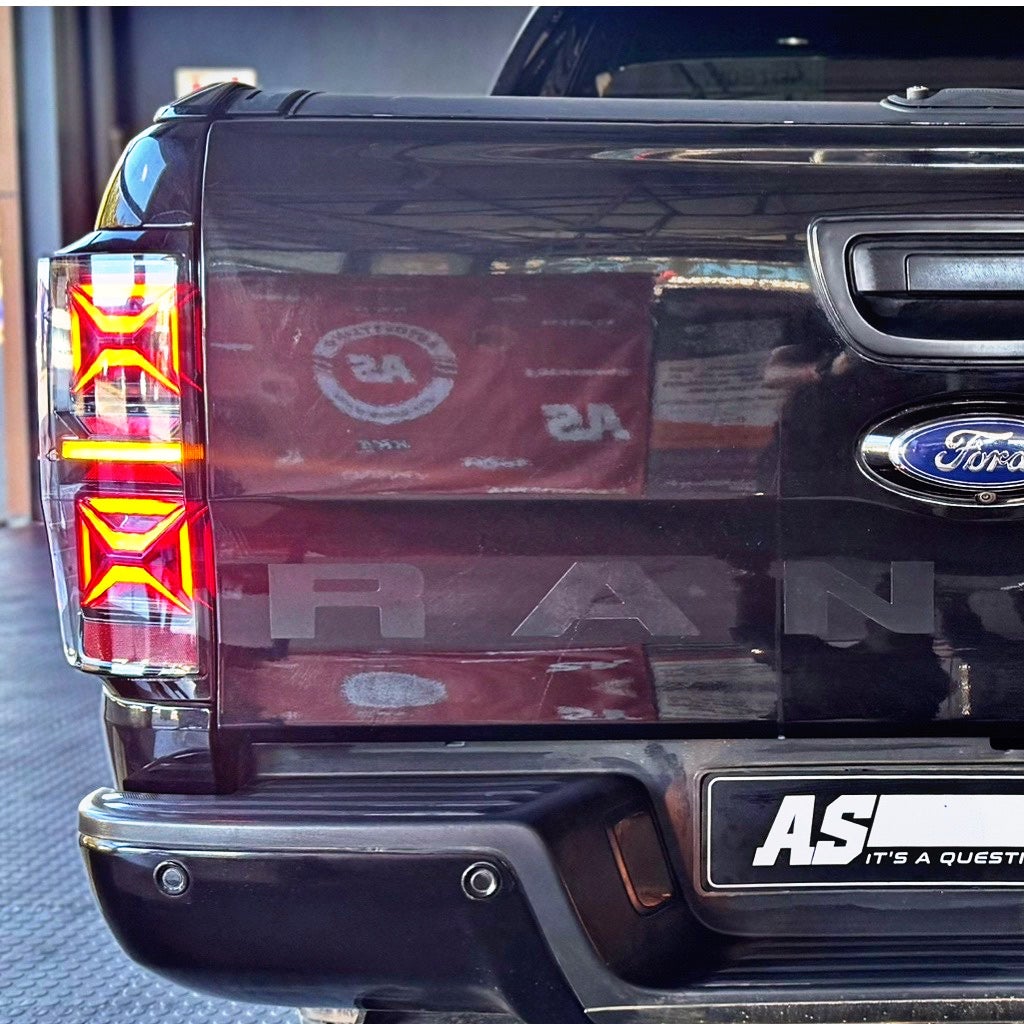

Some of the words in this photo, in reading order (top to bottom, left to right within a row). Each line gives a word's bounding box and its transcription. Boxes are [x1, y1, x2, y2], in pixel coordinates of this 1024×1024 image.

[752, 794, 878, 867] AS
[865, 851, 909, 866] IT'S
[914, 851, 931, 865] A
